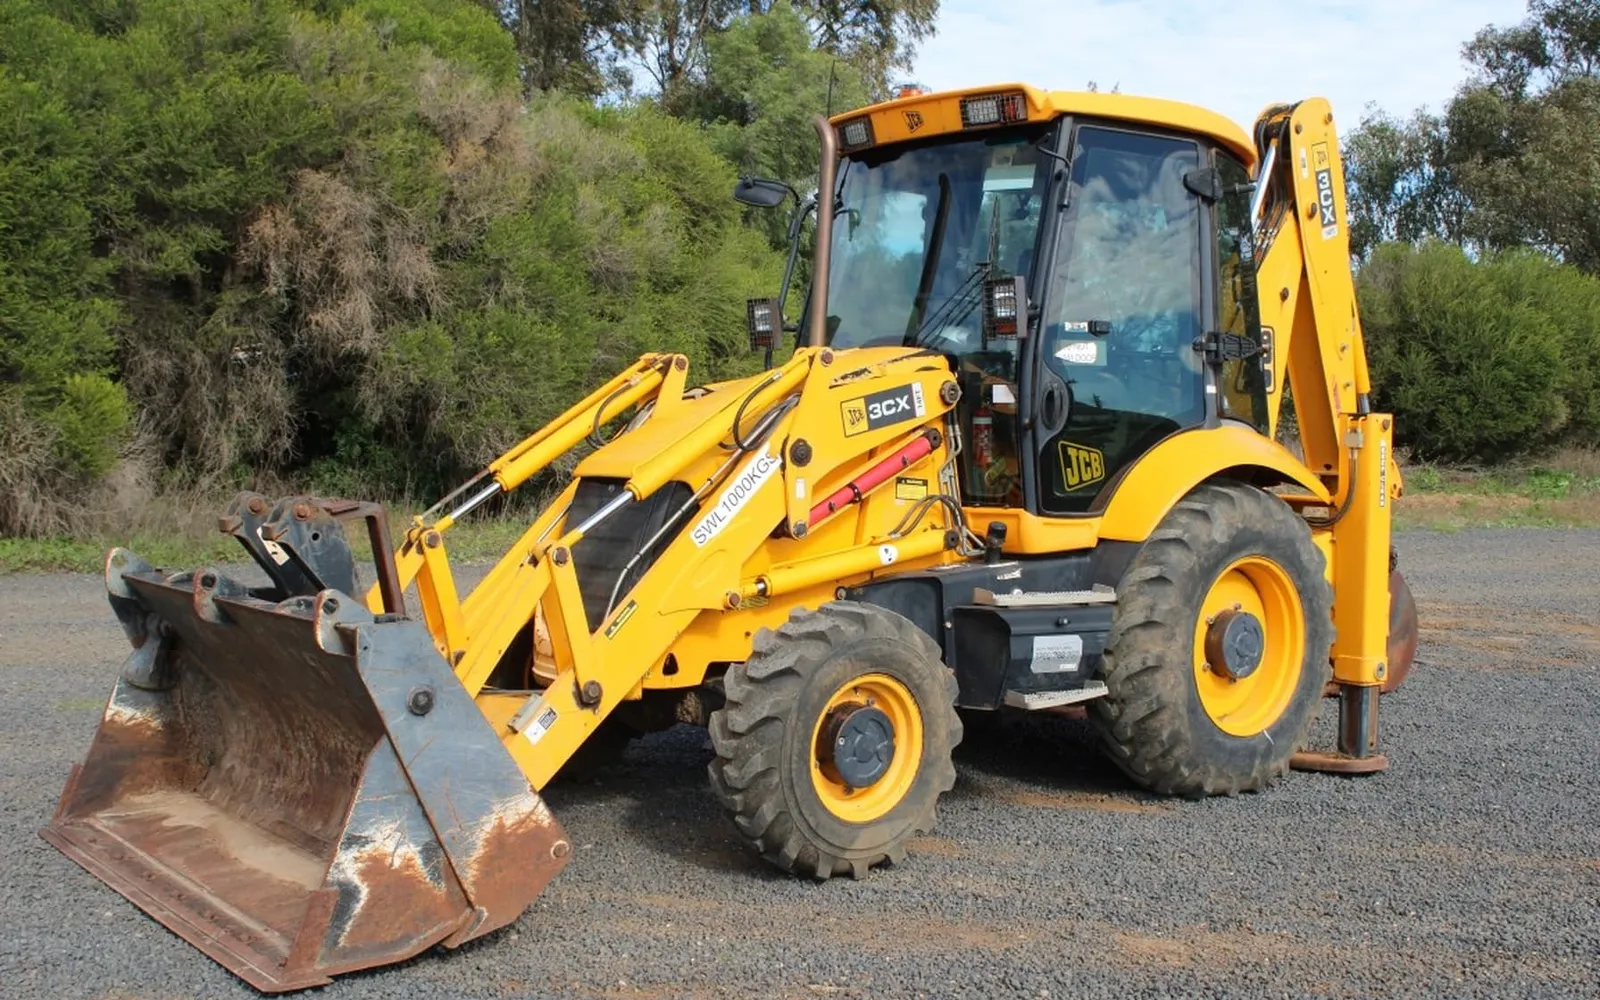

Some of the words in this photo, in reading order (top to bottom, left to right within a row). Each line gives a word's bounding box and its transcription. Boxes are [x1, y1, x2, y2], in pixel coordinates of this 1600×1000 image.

[1317, 171, 1335, 225] 3CX
[868, 394, 911, 420] 3CX
[1066, 446, 1102, 486] JCB
